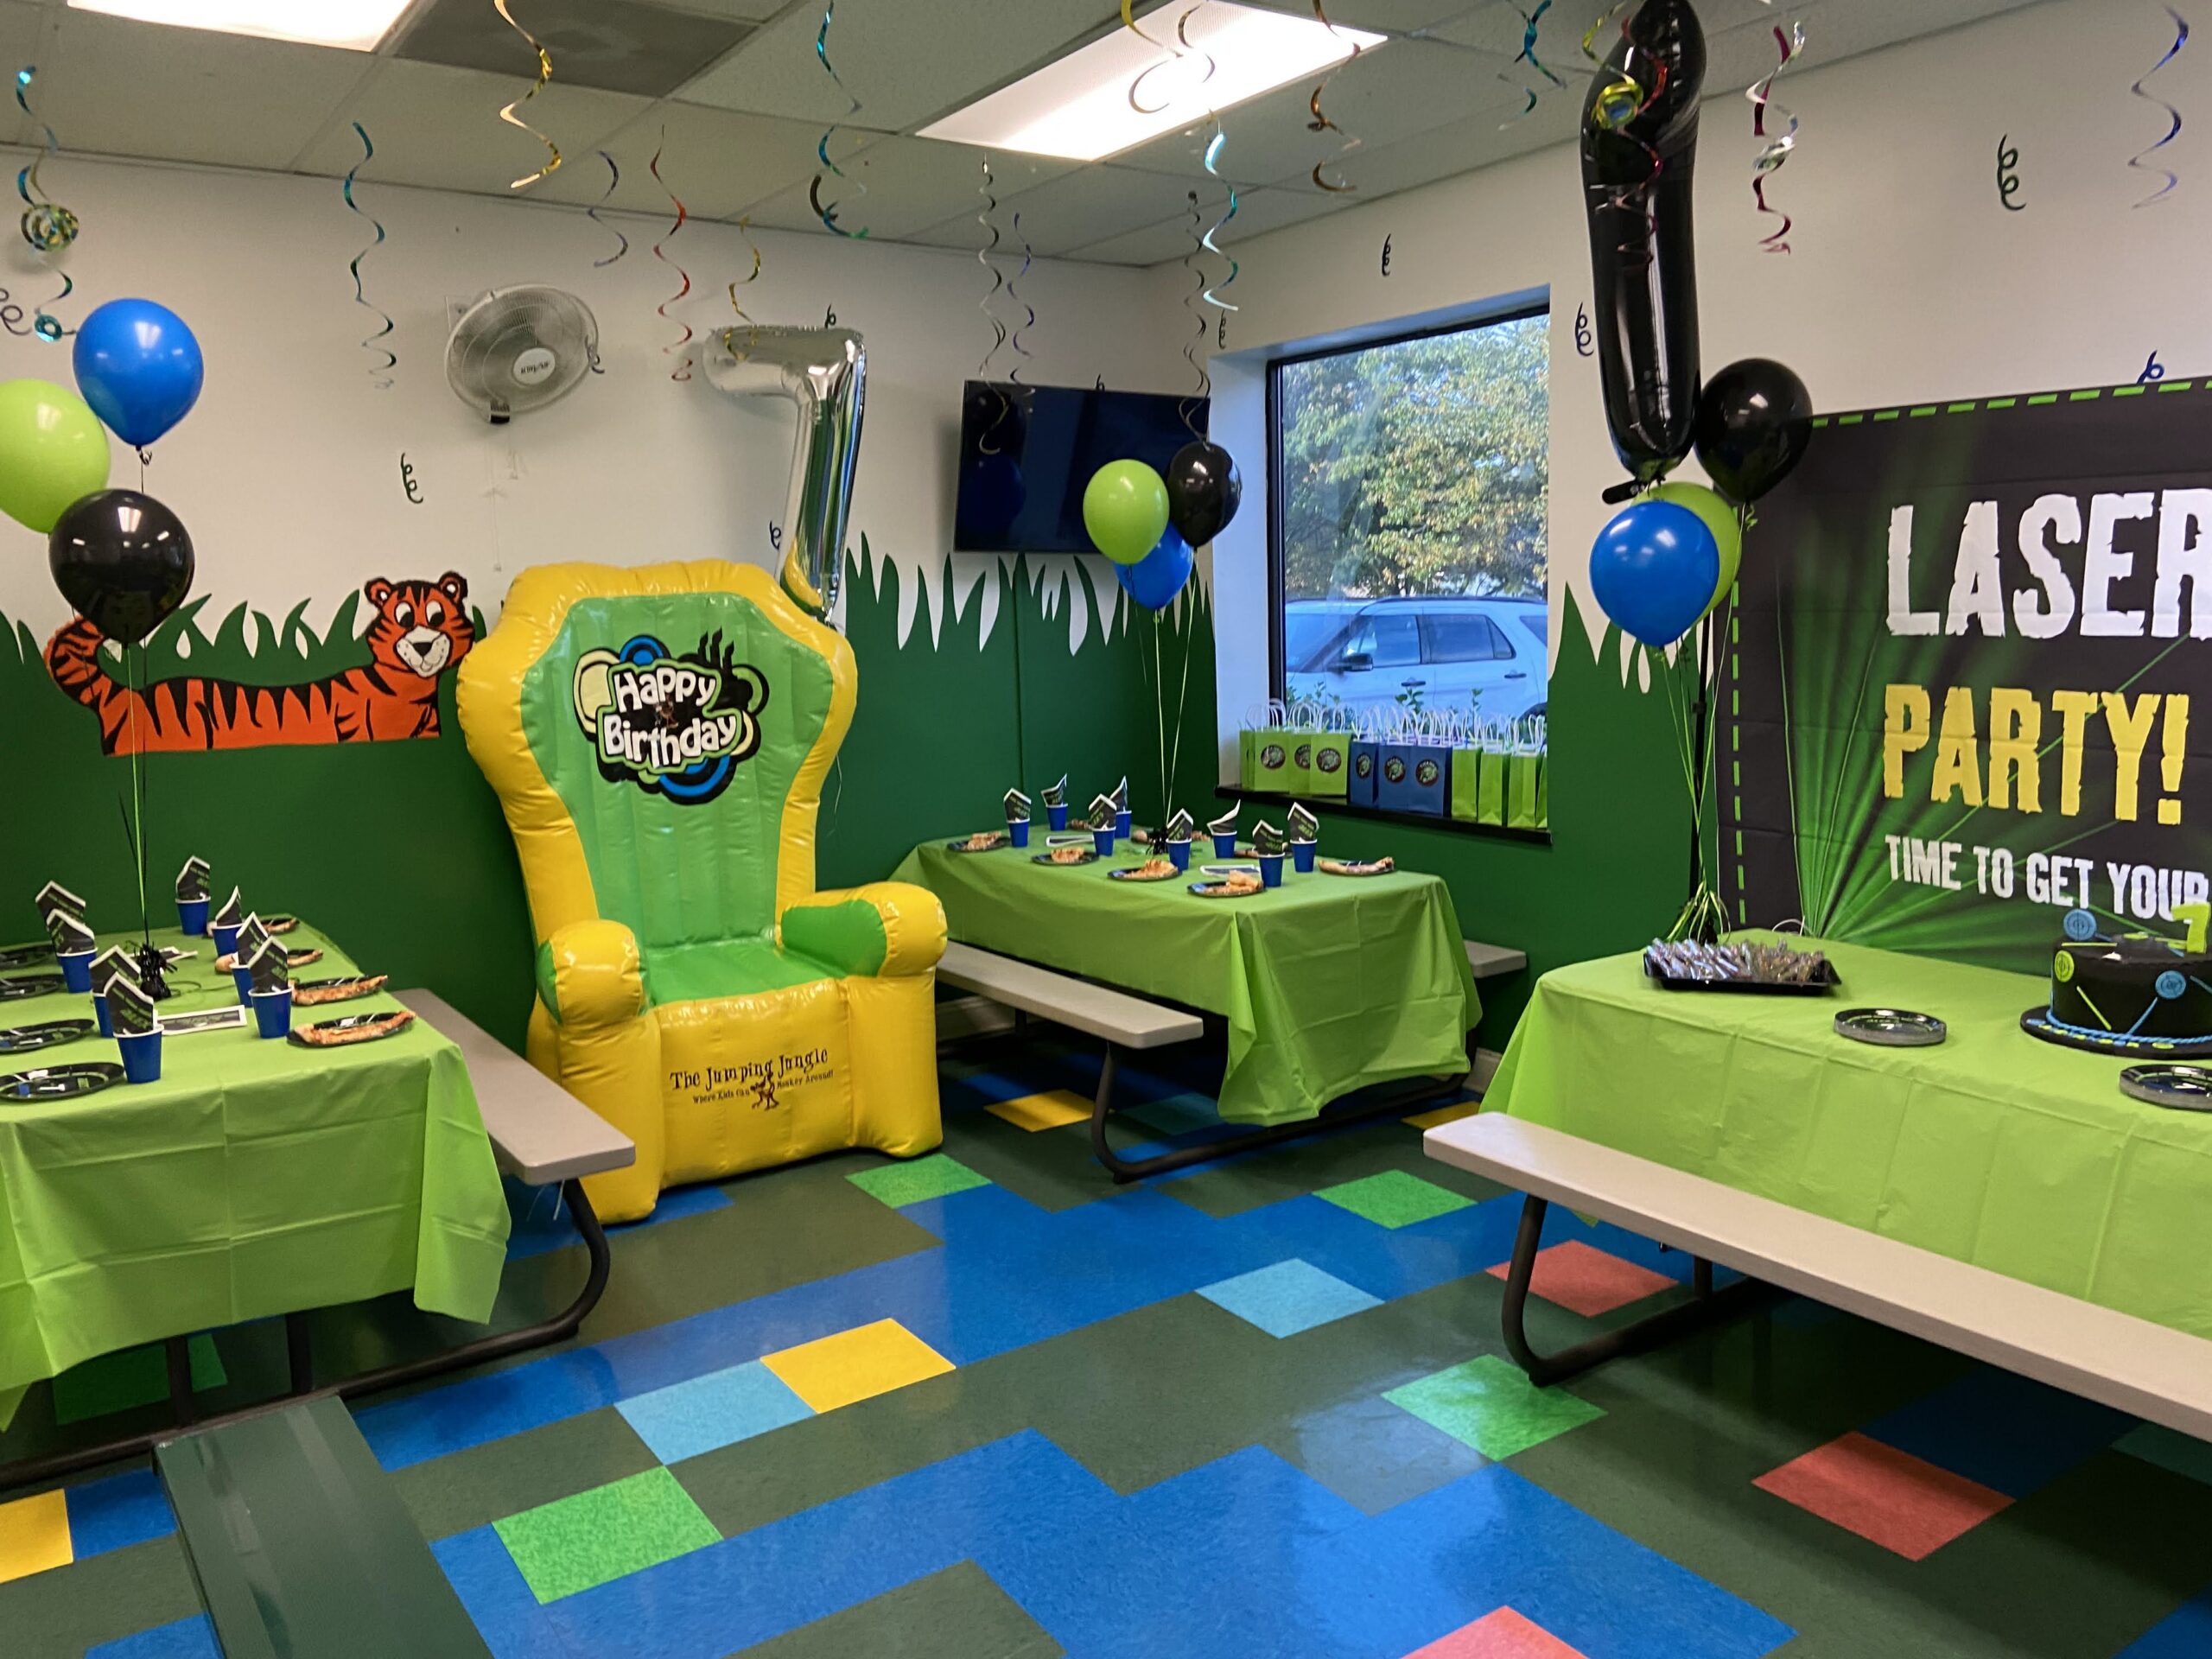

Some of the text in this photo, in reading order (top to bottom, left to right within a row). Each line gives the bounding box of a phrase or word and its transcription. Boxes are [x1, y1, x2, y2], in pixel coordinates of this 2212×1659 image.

[1886, 488, 2212, 640] LASER
[613, 666, 716, 713] Happy
[604, 714, 736, 768] Birthday
[1884, 683, 2190, 825] PARTY!
[1885, 834, 1962, 891] TIME
[1973, 846, 2014, 899] TO
[2026, 852, 2094, 910] GET
[670, 1048, 829, 1091] The Jumping Jungle
